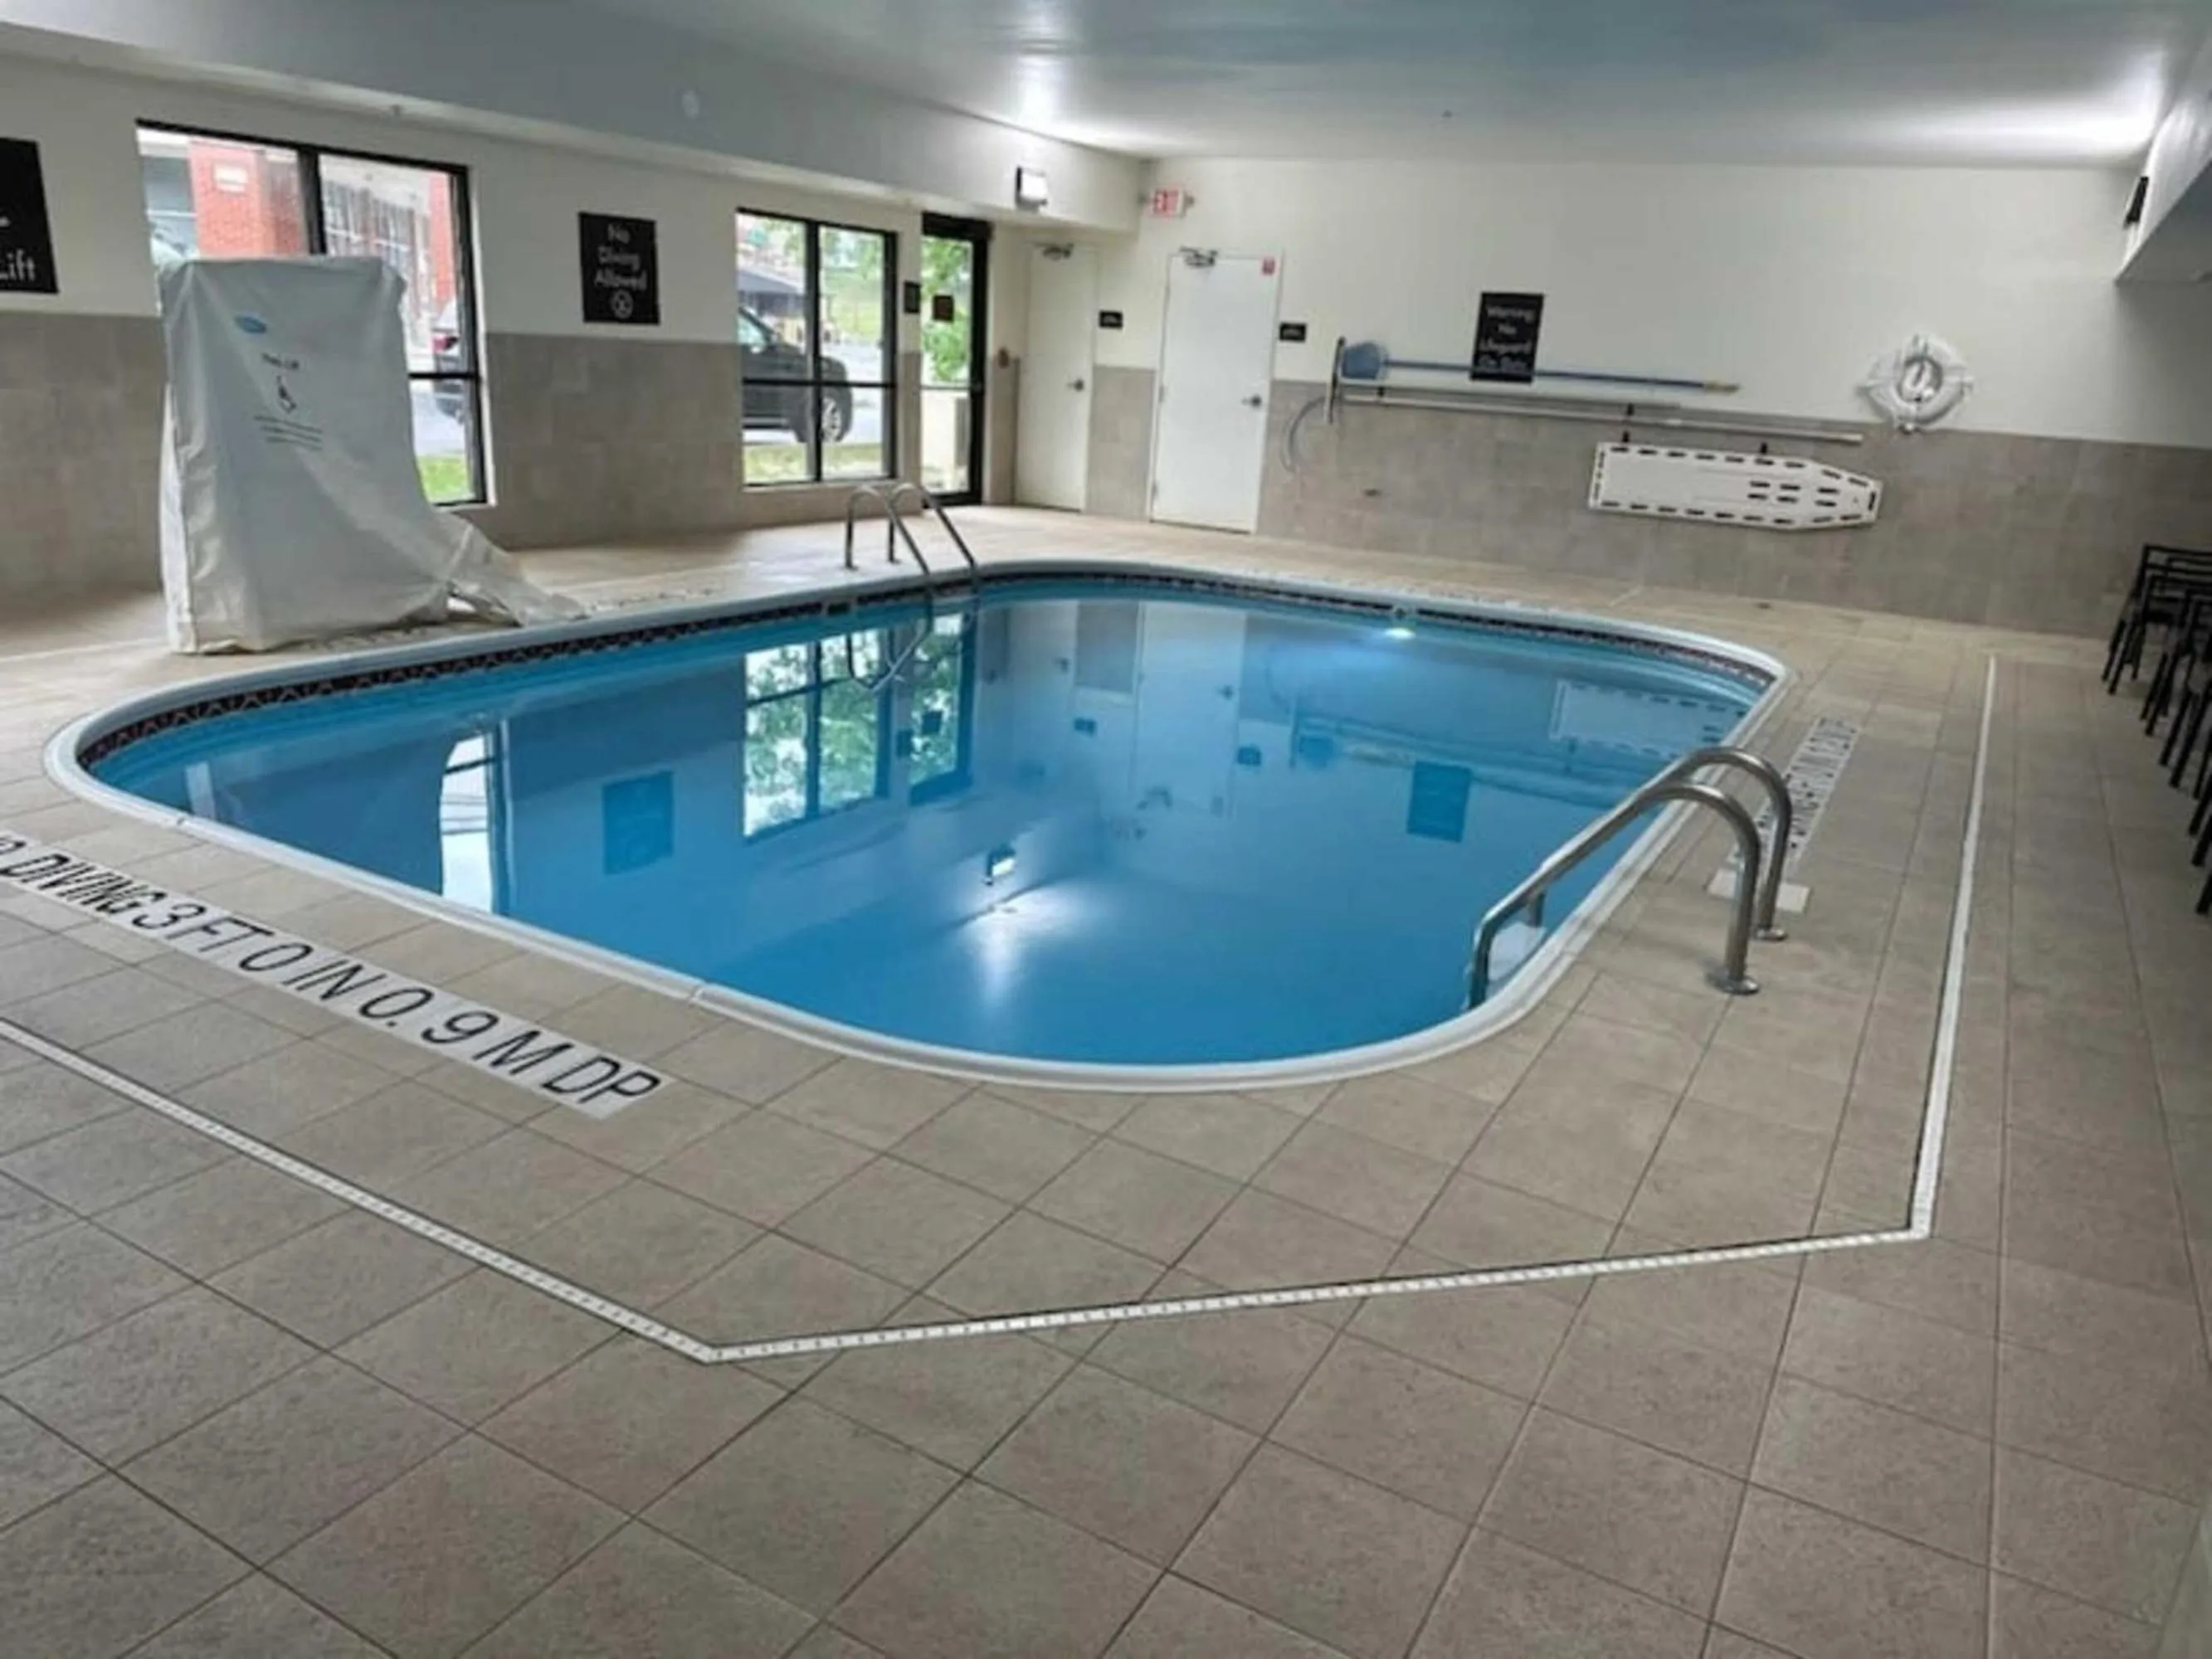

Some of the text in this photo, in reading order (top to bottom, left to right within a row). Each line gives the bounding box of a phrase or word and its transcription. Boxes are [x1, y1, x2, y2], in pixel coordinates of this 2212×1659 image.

[132, 902, 207, 929] 3
[164, 917, 275, 952] FT
[281, 958, 388, 1000] IN
[471, 1030, 573, 1076] M
[540, 1055, 661, 1105] DP
